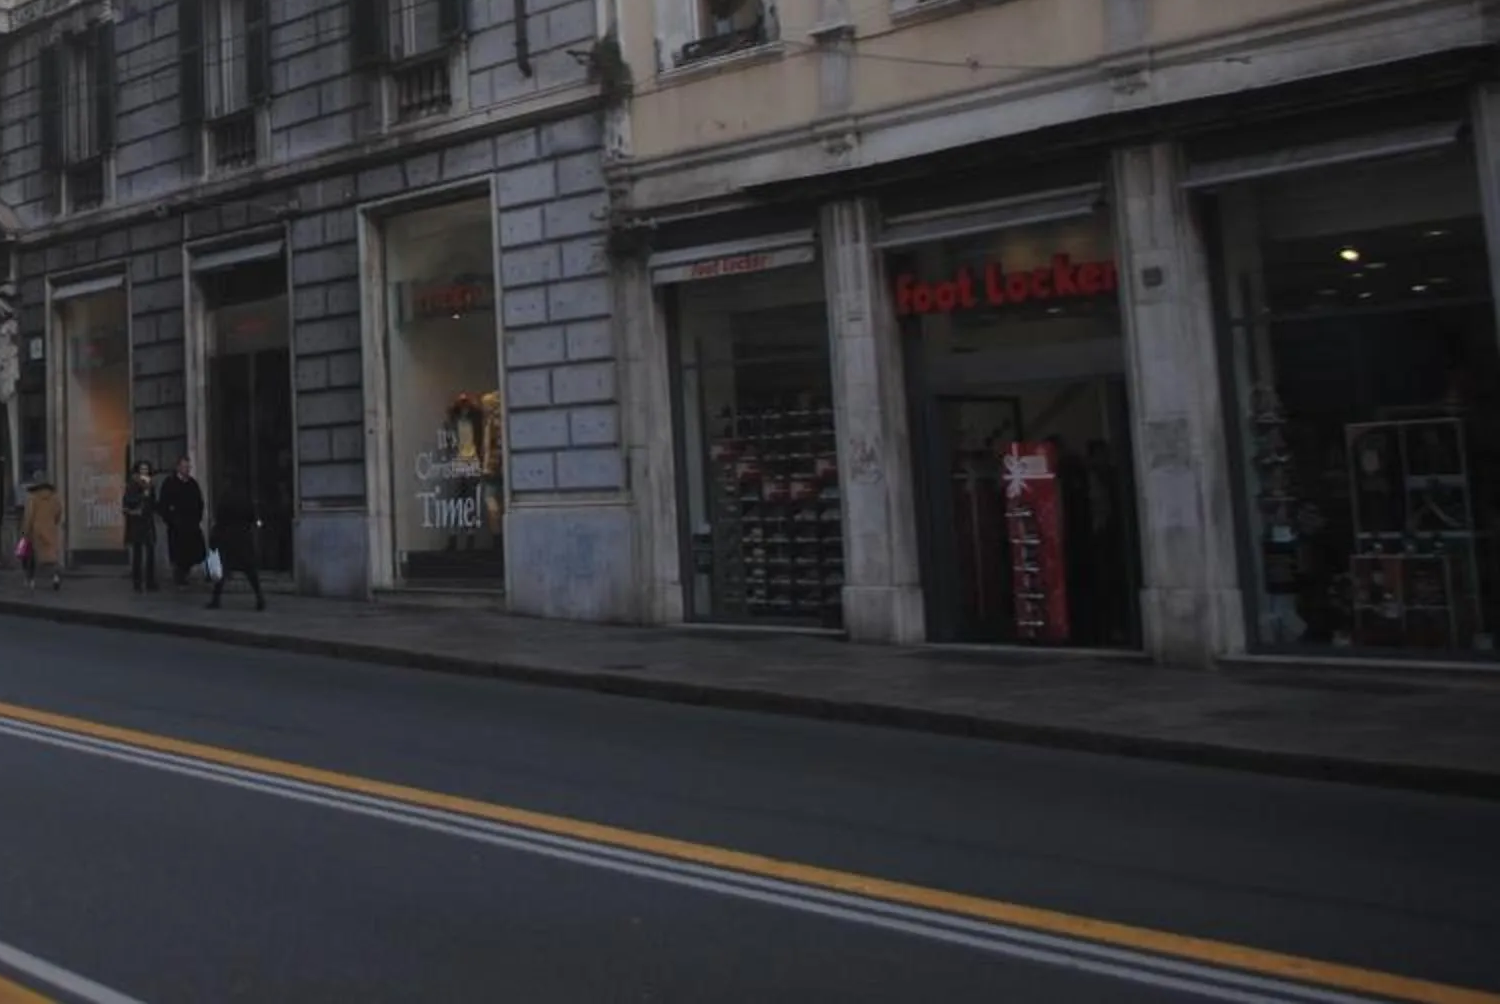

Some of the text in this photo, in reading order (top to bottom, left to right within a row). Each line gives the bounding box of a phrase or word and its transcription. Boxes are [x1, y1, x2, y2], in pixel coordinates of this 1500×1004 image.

[897, 253, 1117, 315] Foot Locker
[415, 482, 484, 529] Time!
